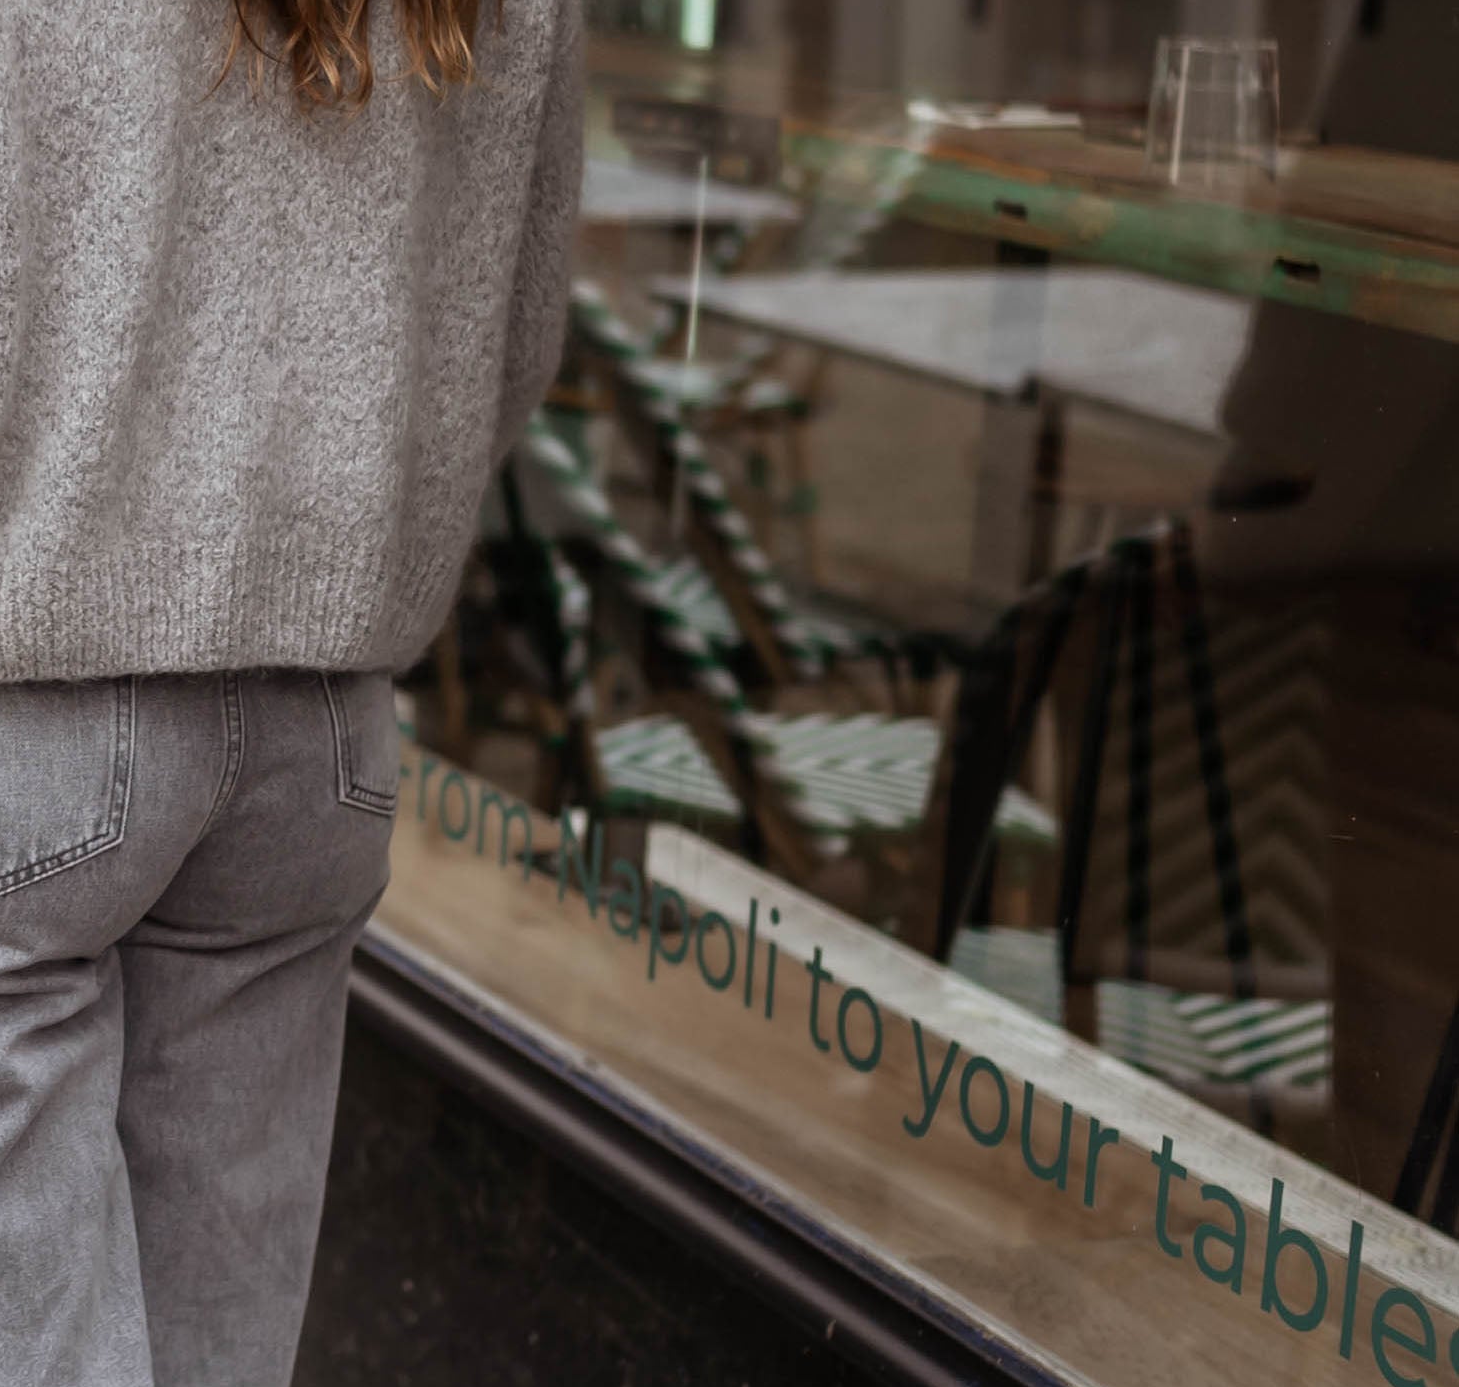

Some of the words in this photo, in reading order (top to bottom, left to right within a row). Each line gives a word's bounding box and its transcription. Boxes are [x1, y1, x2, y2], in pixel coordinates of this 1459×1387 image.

[557, 806, 780, 1020] Napoli
[805, 945, 883, 1073] to
[902, 1017, 1120, 1209] your
